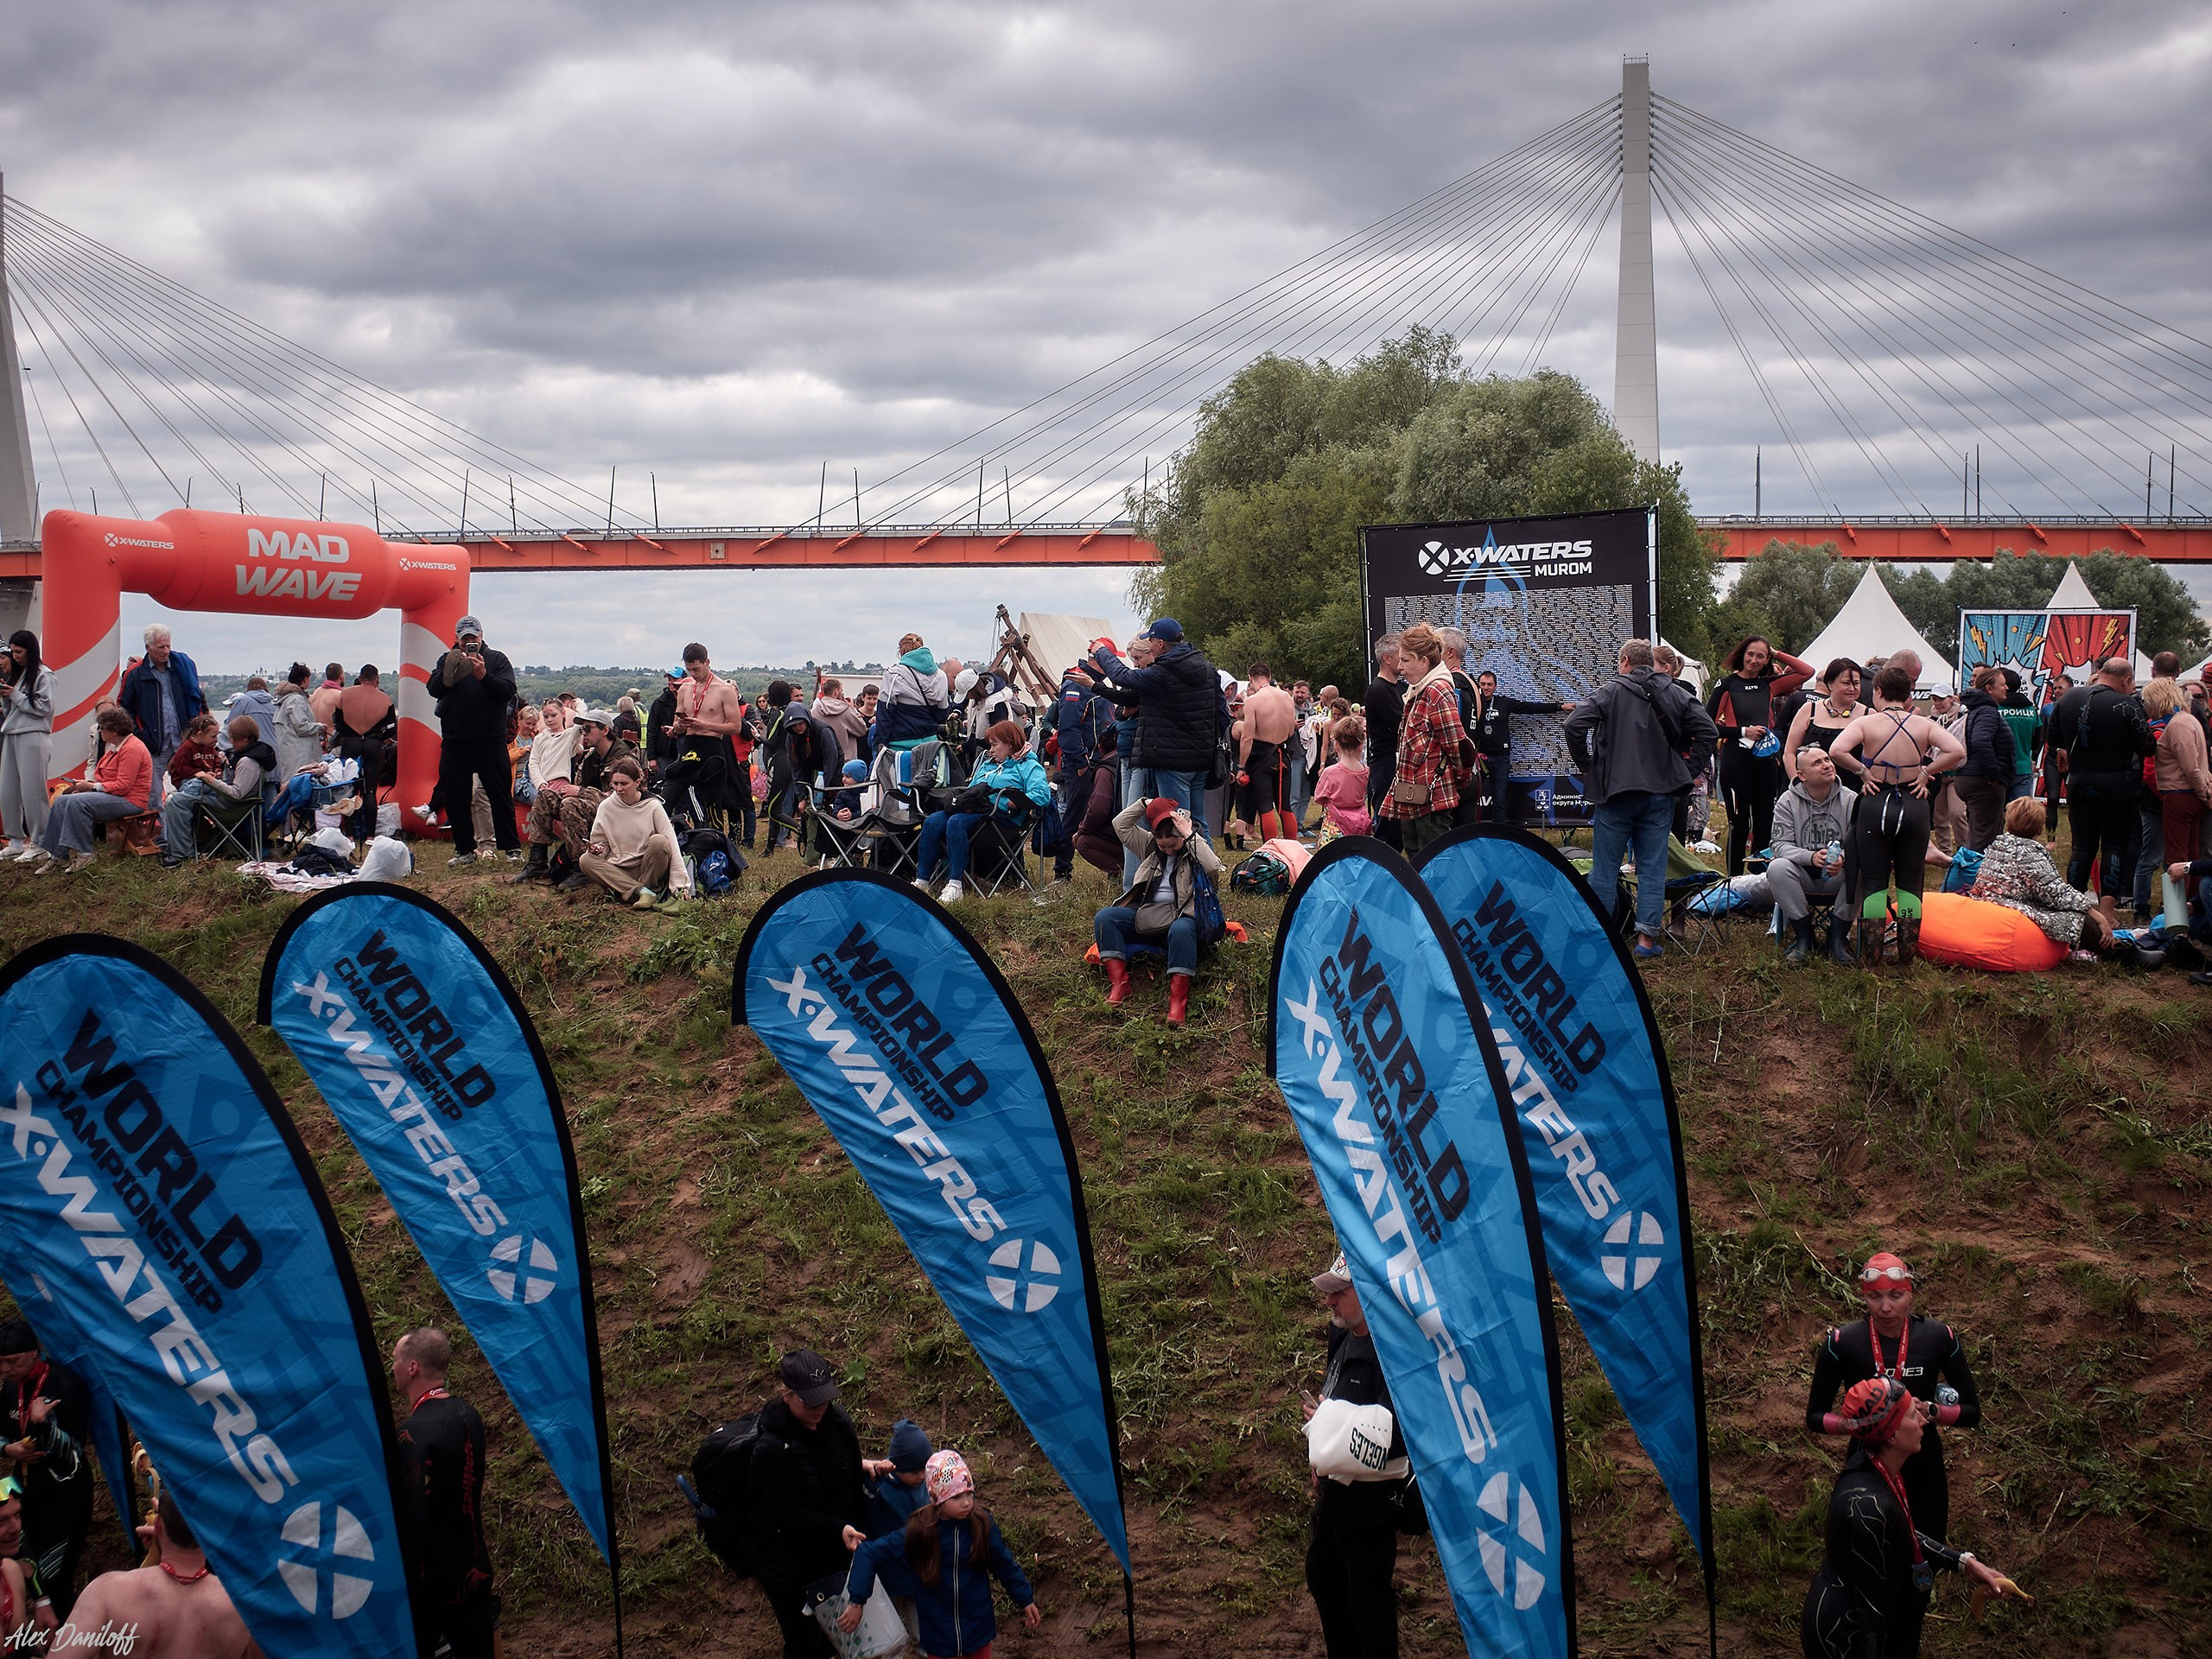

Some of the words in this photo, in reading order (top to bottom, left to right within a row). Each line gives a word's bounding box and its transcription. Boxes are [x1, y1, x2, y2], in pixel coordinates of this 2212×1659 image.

[236, 564, 362, 601] WAVE
[248, 528, 349, 563] MAD
[1535, 562, 1592, 577] MUROM
[1998, 709, 2035, 717] ТРОИЦК
[334, 957, 462, 1121] CHAMPIONSHIP
[356, 929, 496, 1108] WORLD
[810, 952, 956, 1122] CHAMPIONSHIP
[835, 921, 988, 1107] WORLD
[1337, 904, 1471, 1223] WORLD
[1452, 917, 1580, 1094] CHAMPIONSHIP
[1474, 879, 1606, 1075] WORLD
[35, 1059, 222, 1313] CHAMPIONSHIP
[62, 1008, 263, 1289] WORLD
[1319, 955, 1442, 1245] CHAMPIONSHIP
